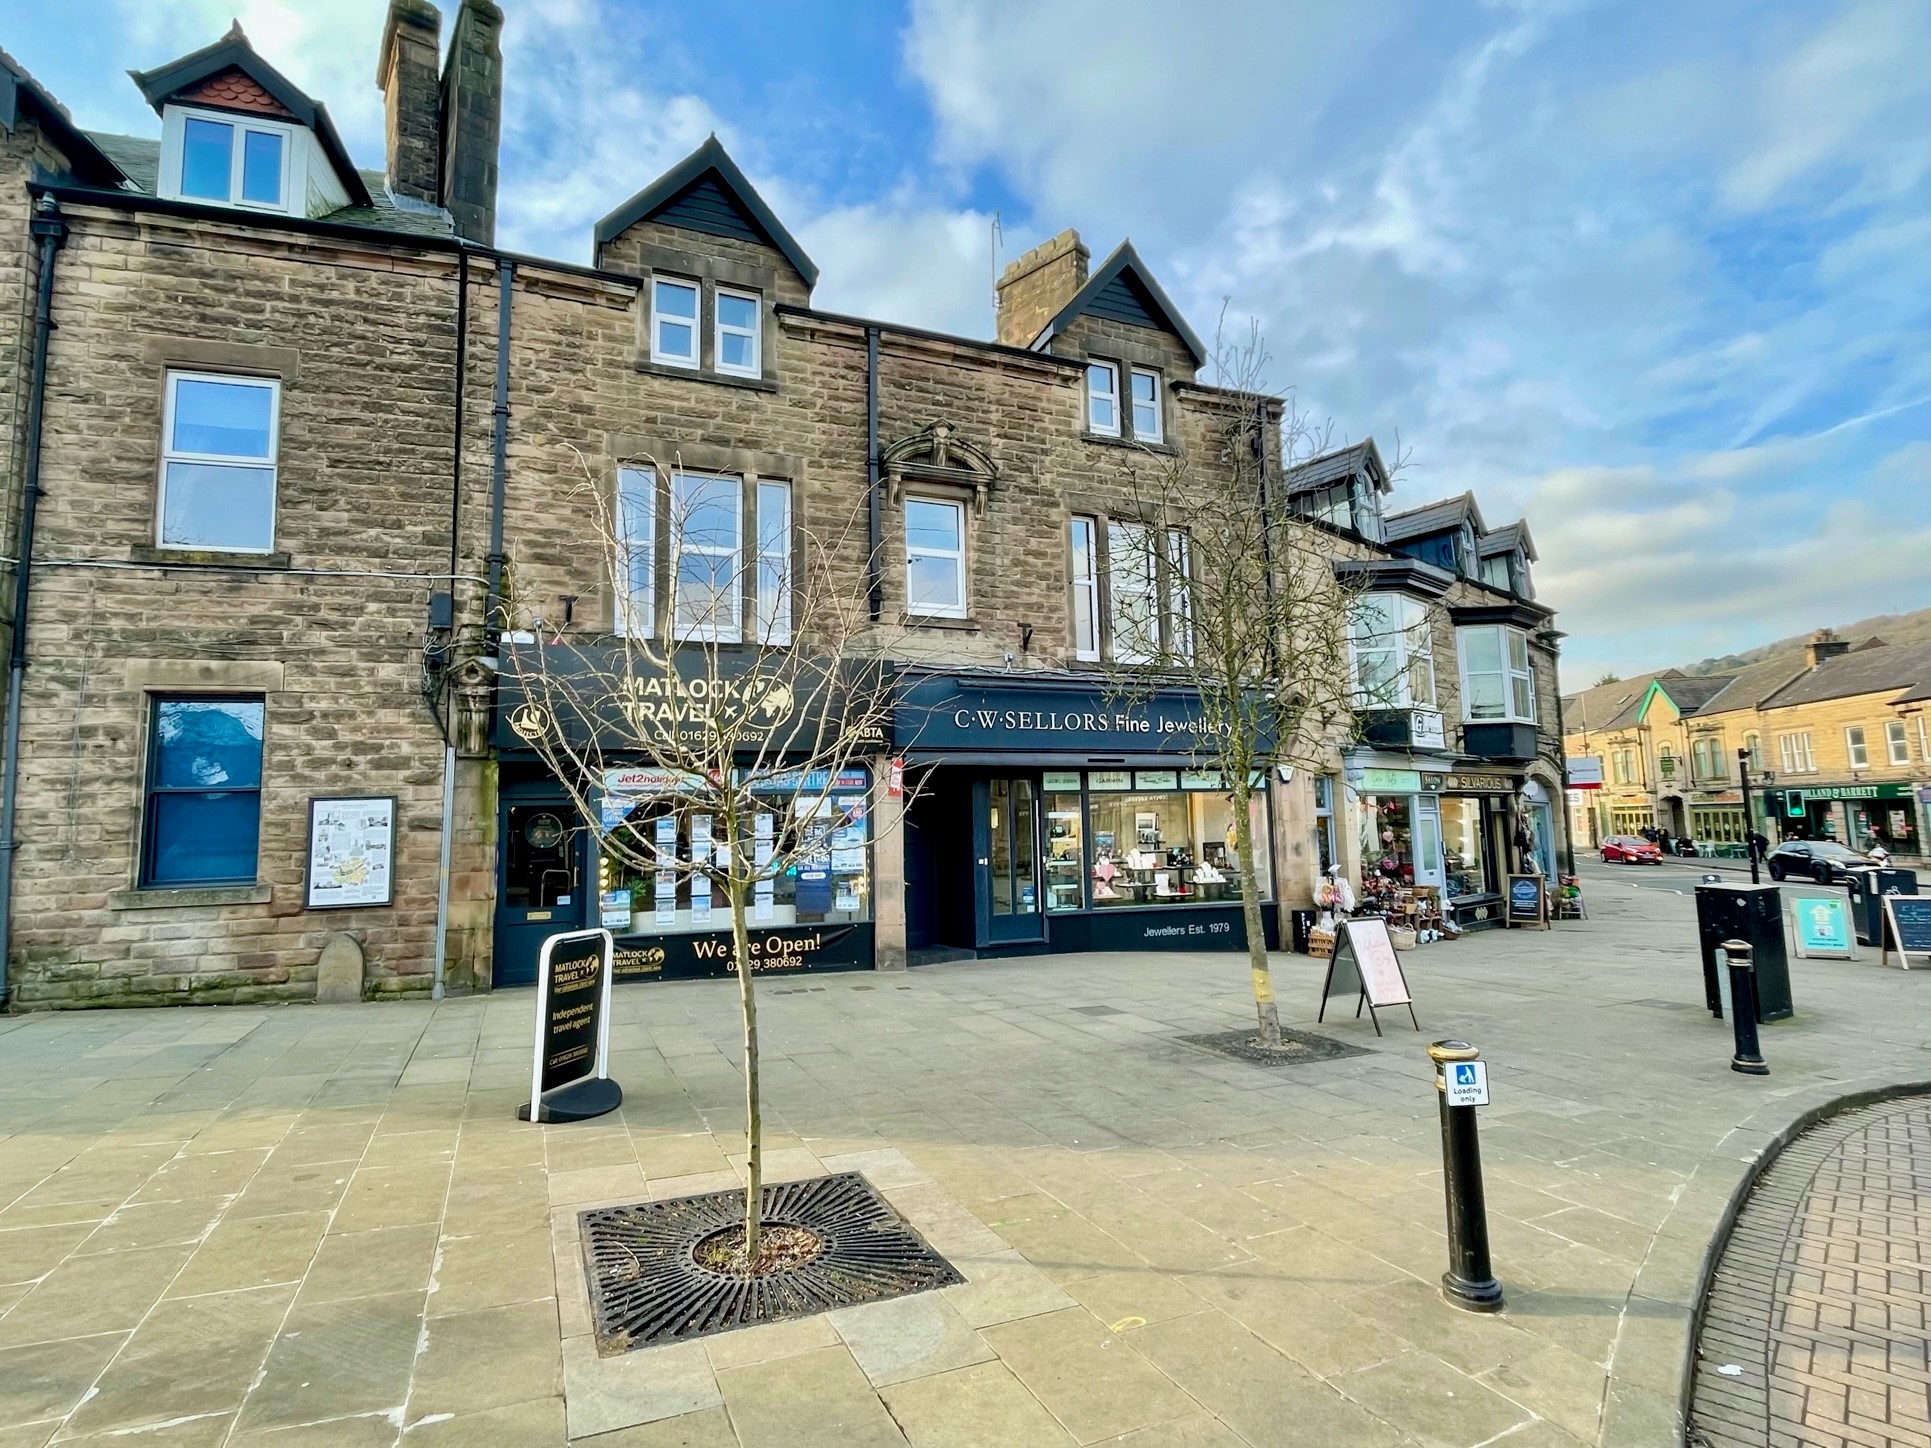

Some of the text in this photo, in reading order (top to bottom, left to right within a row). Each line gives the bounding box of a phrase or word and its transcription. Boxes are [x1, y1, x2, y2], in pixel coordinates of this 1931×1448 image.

[622, 676, 740, 698] MATLOCK
[859, 727, 884, 739] ABTA
[1115, 714, 1150, 733] Fine
[1156, 715, 1232, 738] Jewellery
[1461, 776, 1502, 790] SILVARIOUS
[1802, 788, 1832, 798] OLLAND
[1840, 786, 1879, 798] BARRETT
[1143, 922, 1230, 938] Jewellers Est. 1979
[692, 940, 727, 959] We
[766, 933, 821, 957] Open!
[554, 959, 586, 973] MATLOCK
[613, 958, 641, 967] TRAVEL
[726, 956, 803, 972] 0129 380692
[554, 971, 580, 984] TRAVEL
[552, 1002, 594, 1021] Independent
[553, 1016, 591, 1035] travel agent
[1453, 1087, 1482, 1095] Loading
